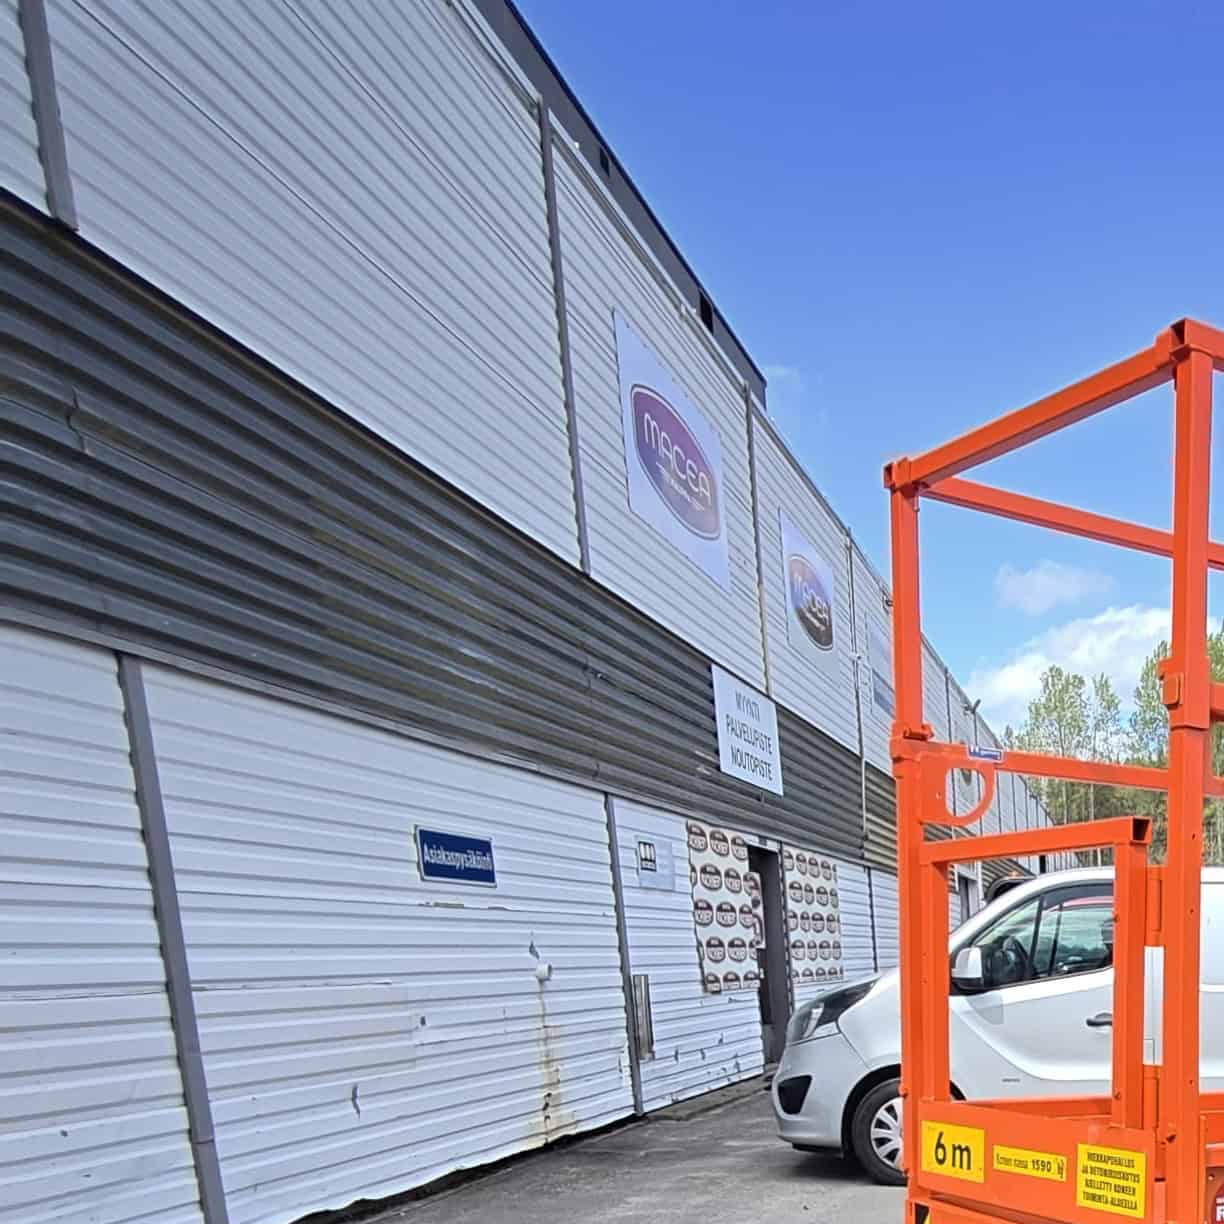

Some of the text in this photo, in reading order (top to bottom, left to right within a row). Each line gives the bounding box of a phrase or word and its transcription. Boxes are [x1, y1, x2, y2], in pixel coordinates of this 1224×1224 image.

[731, 744, 772, 781] NOUTOPISTE
[934, 1131, 971, 1170] 6 m
[1031, 1159, 1052, 1173] 1590
